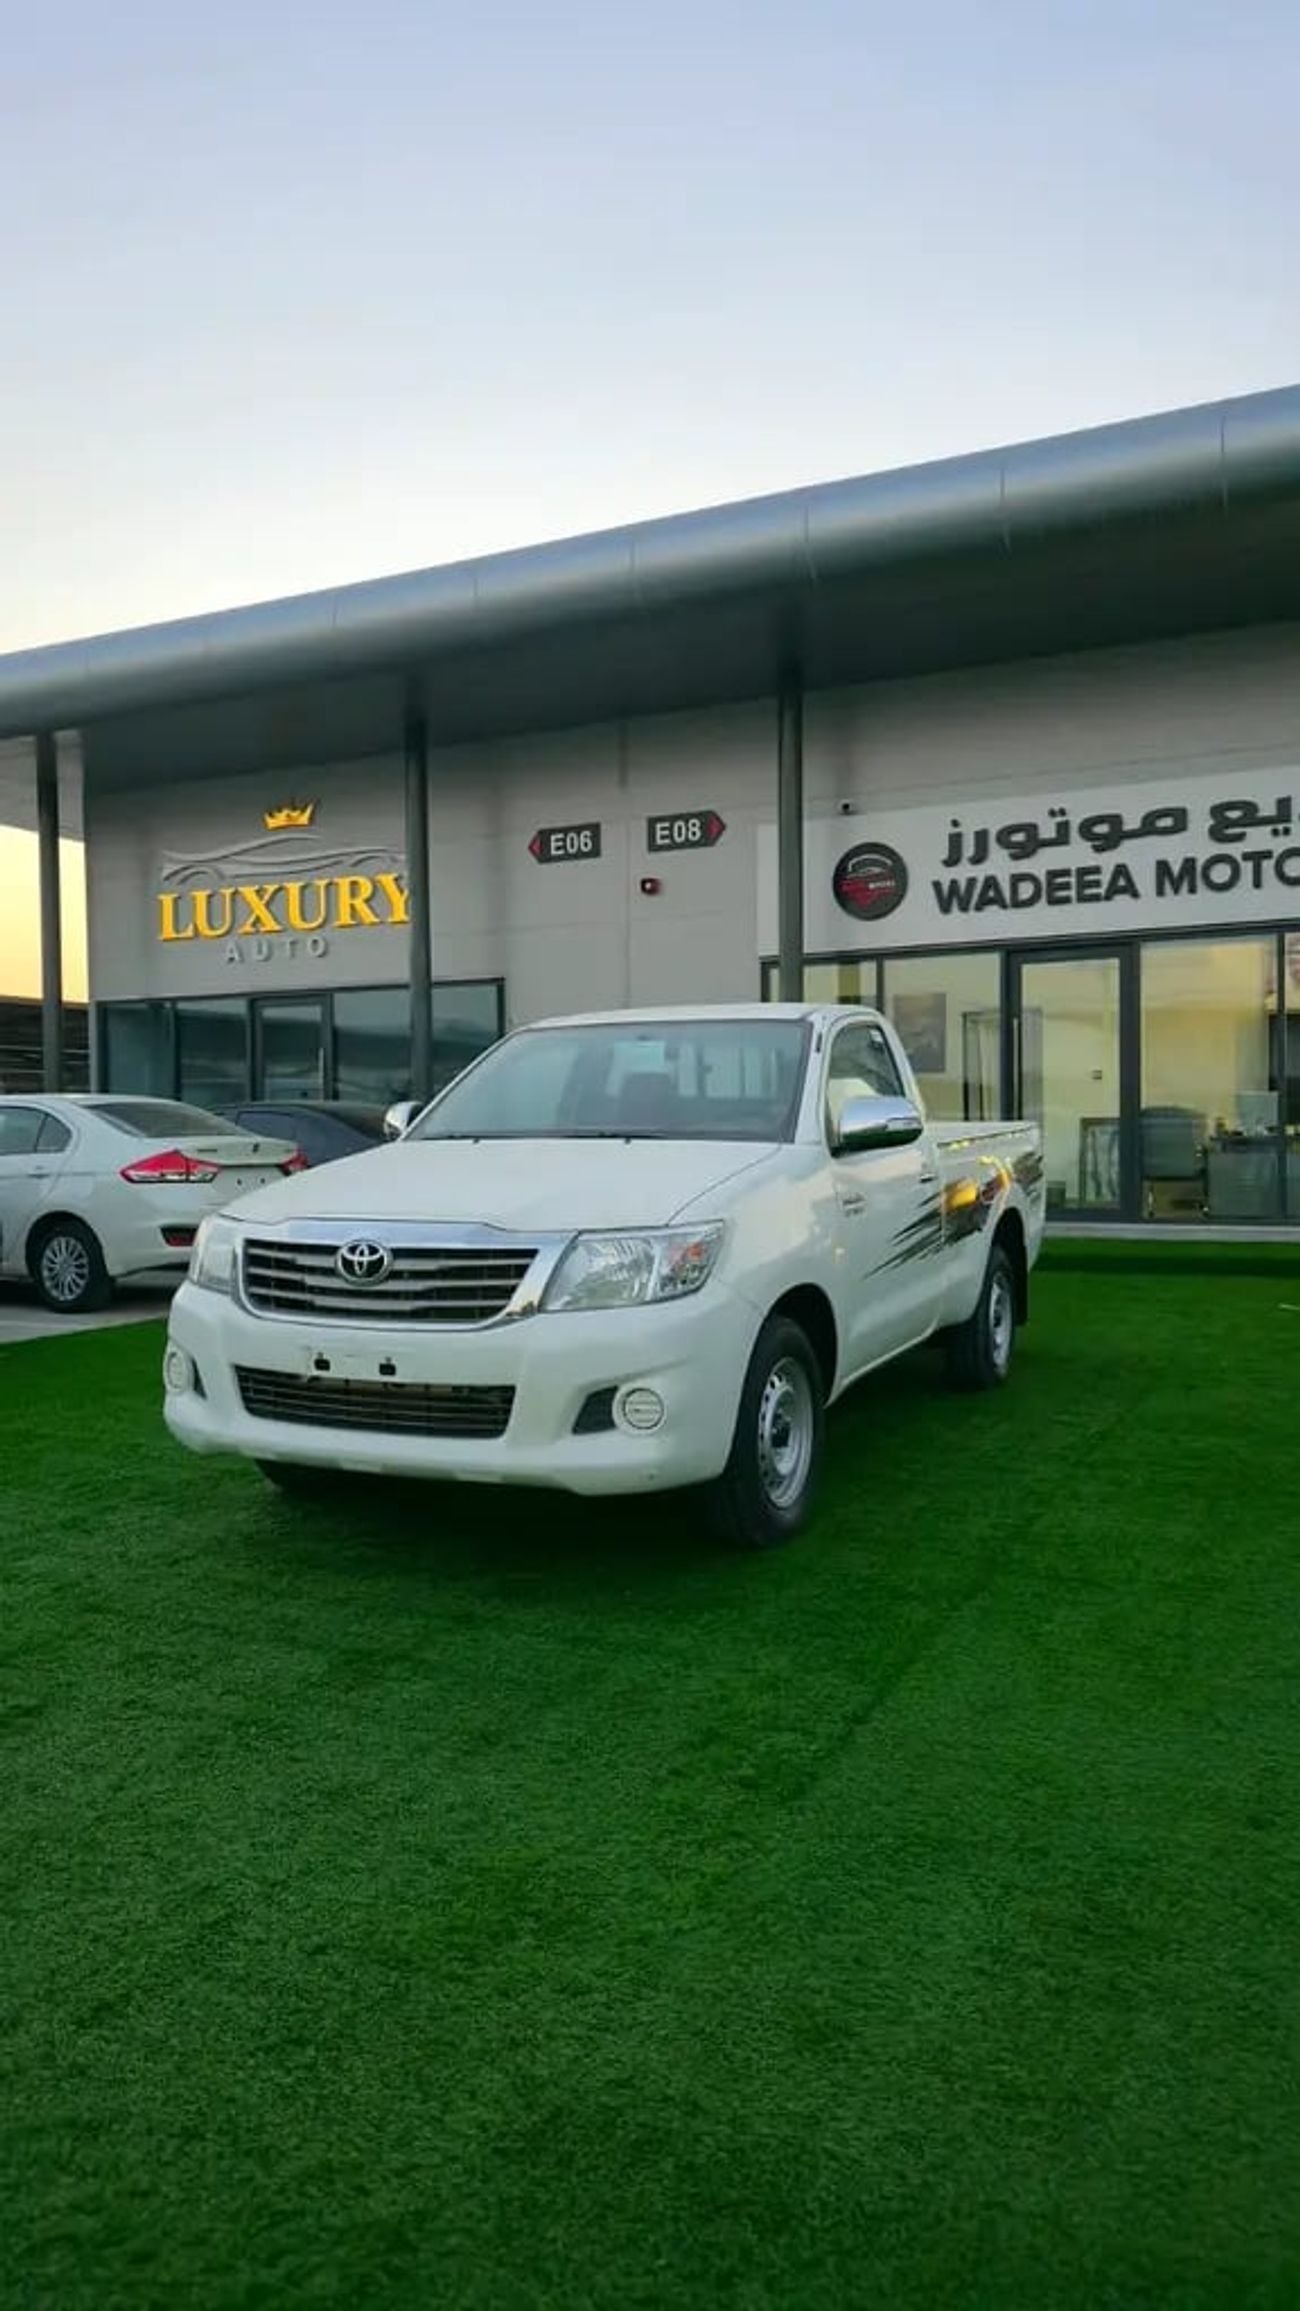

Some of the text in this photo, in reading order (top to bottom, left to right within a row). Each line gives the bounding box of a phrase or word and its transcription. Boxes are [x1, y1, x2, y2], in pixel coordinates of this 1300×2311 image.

[550, 830, 593, 855] E06
[655, 818, 701, 845] E08
[941, 795, 1300, 868] يع موتورز
[931, 846, 1300, 915] WADEEA MOTO
[158, 872, 411, 941] LUXURY
[224, 935, 329, 965] AUTO
